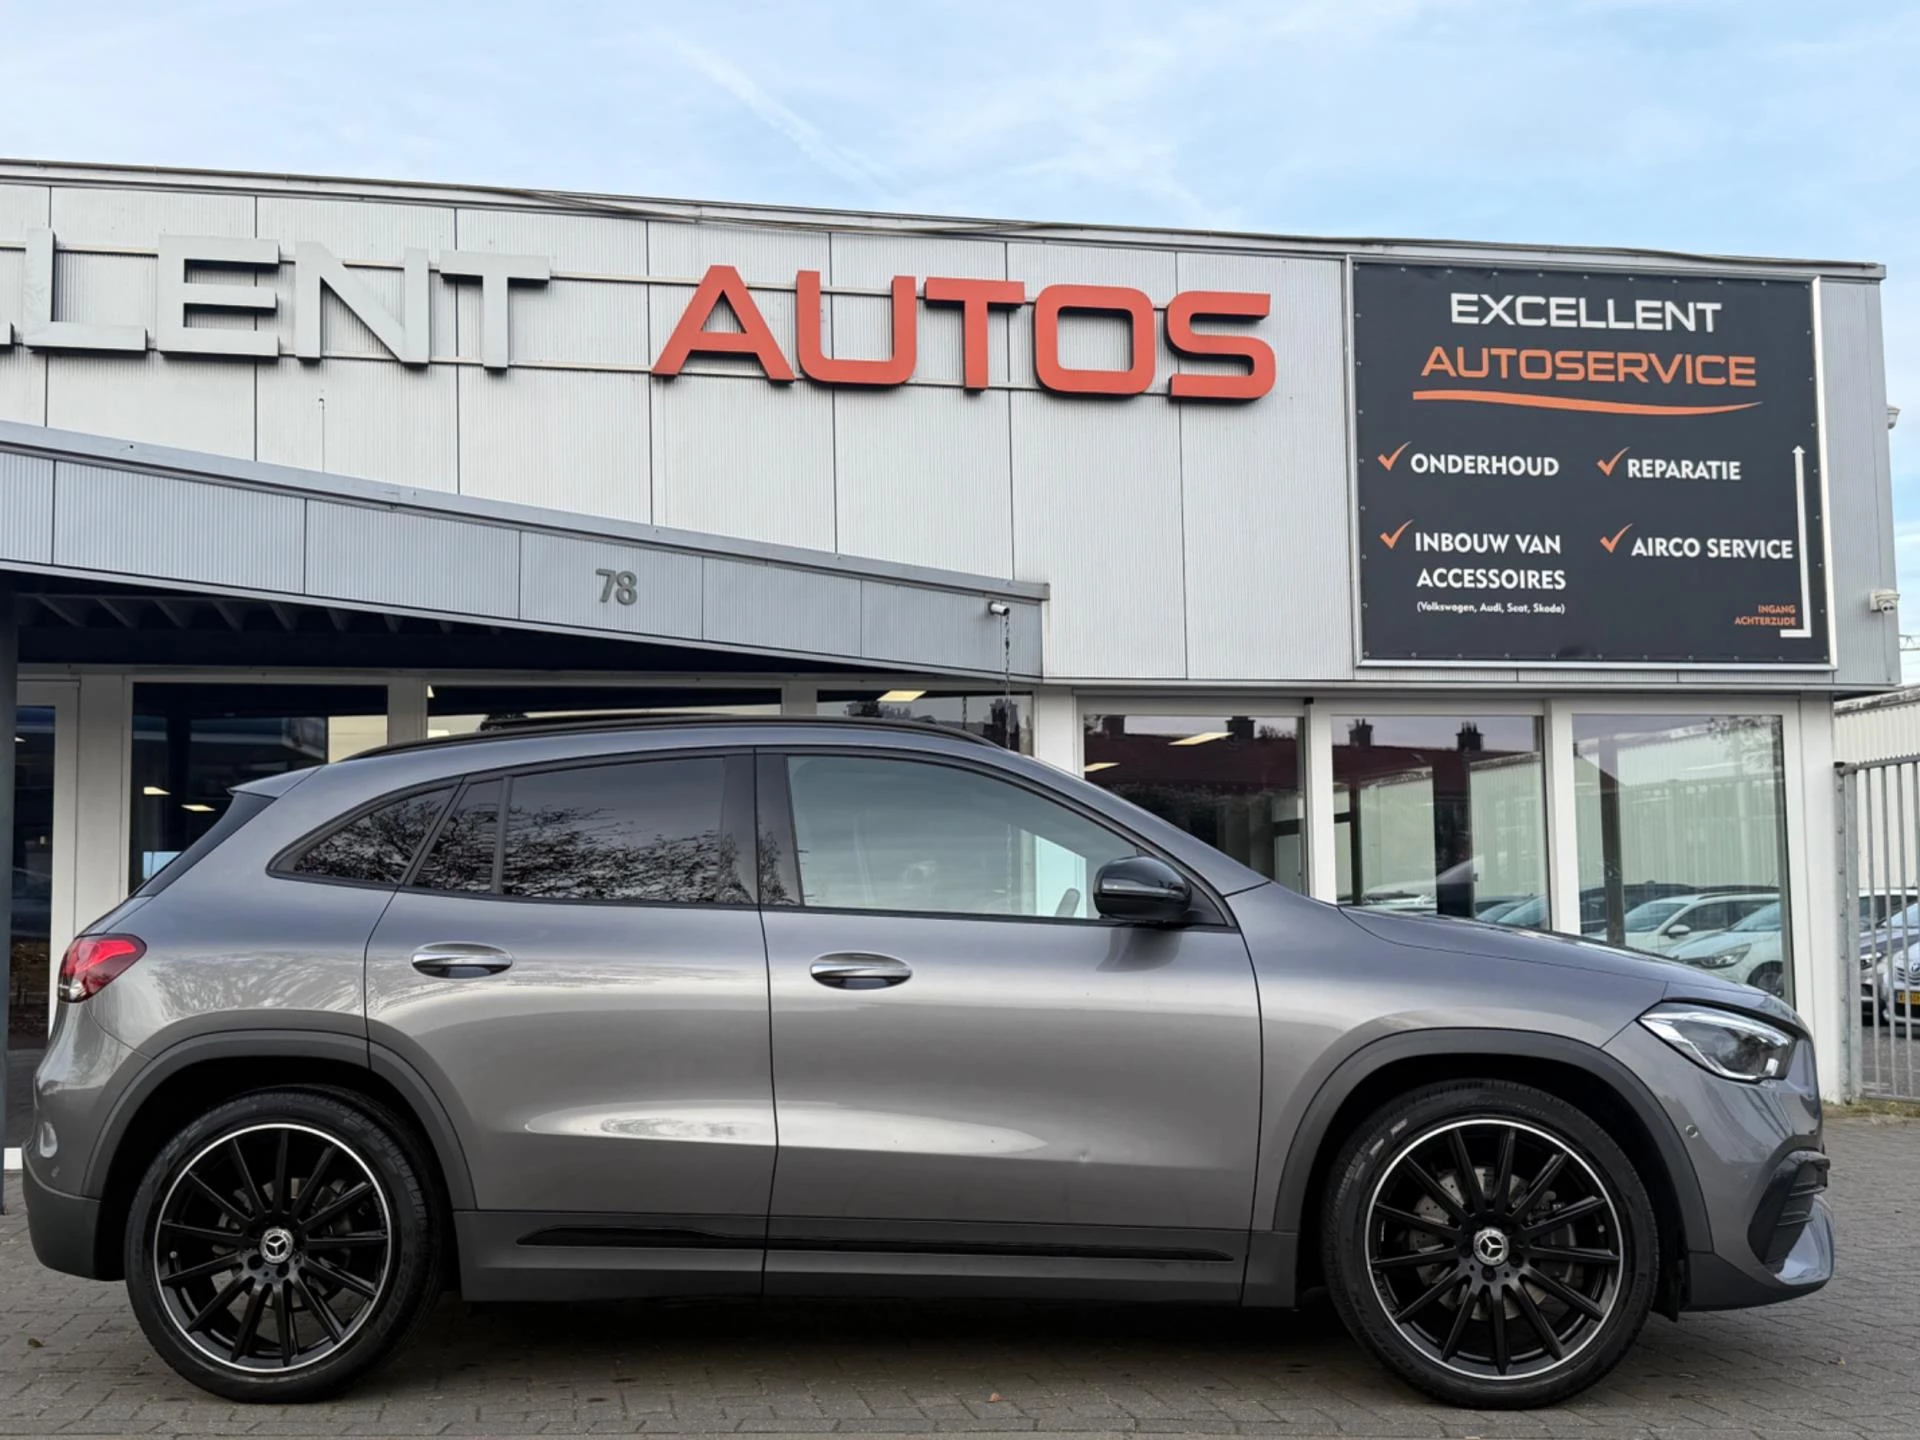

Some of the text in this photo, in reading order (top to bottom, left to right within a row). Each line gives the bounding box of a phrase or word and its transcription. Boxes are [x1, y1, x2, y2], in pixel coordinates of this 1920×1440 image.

[0, 228, 1277, 402] LENT AUTOS
[1450, 292, 1722, 333] EXCELLENT
[1420, 345, 1757, 387] AUTOSERVICE
[1410, 452, 1560, 477] ONDERHOUD
[1627, 458, 1742, 481] REPARATIE
[1414, 531, 1562, 555] INBOUW VAN
[1630, 536, 1794, 560] AIRCO SERVICE
[595, 568, 638, 606] 78
[1415, 567, 1567, 591] ACCESSOIRES
[1416, 601, 1478, 614] (Volkswagen,
[1479, 602, 1505, 614] Audi,
[1532, 602, 1566, 615] Skoda)
[1758, 604, 1796, 614] INGANG
